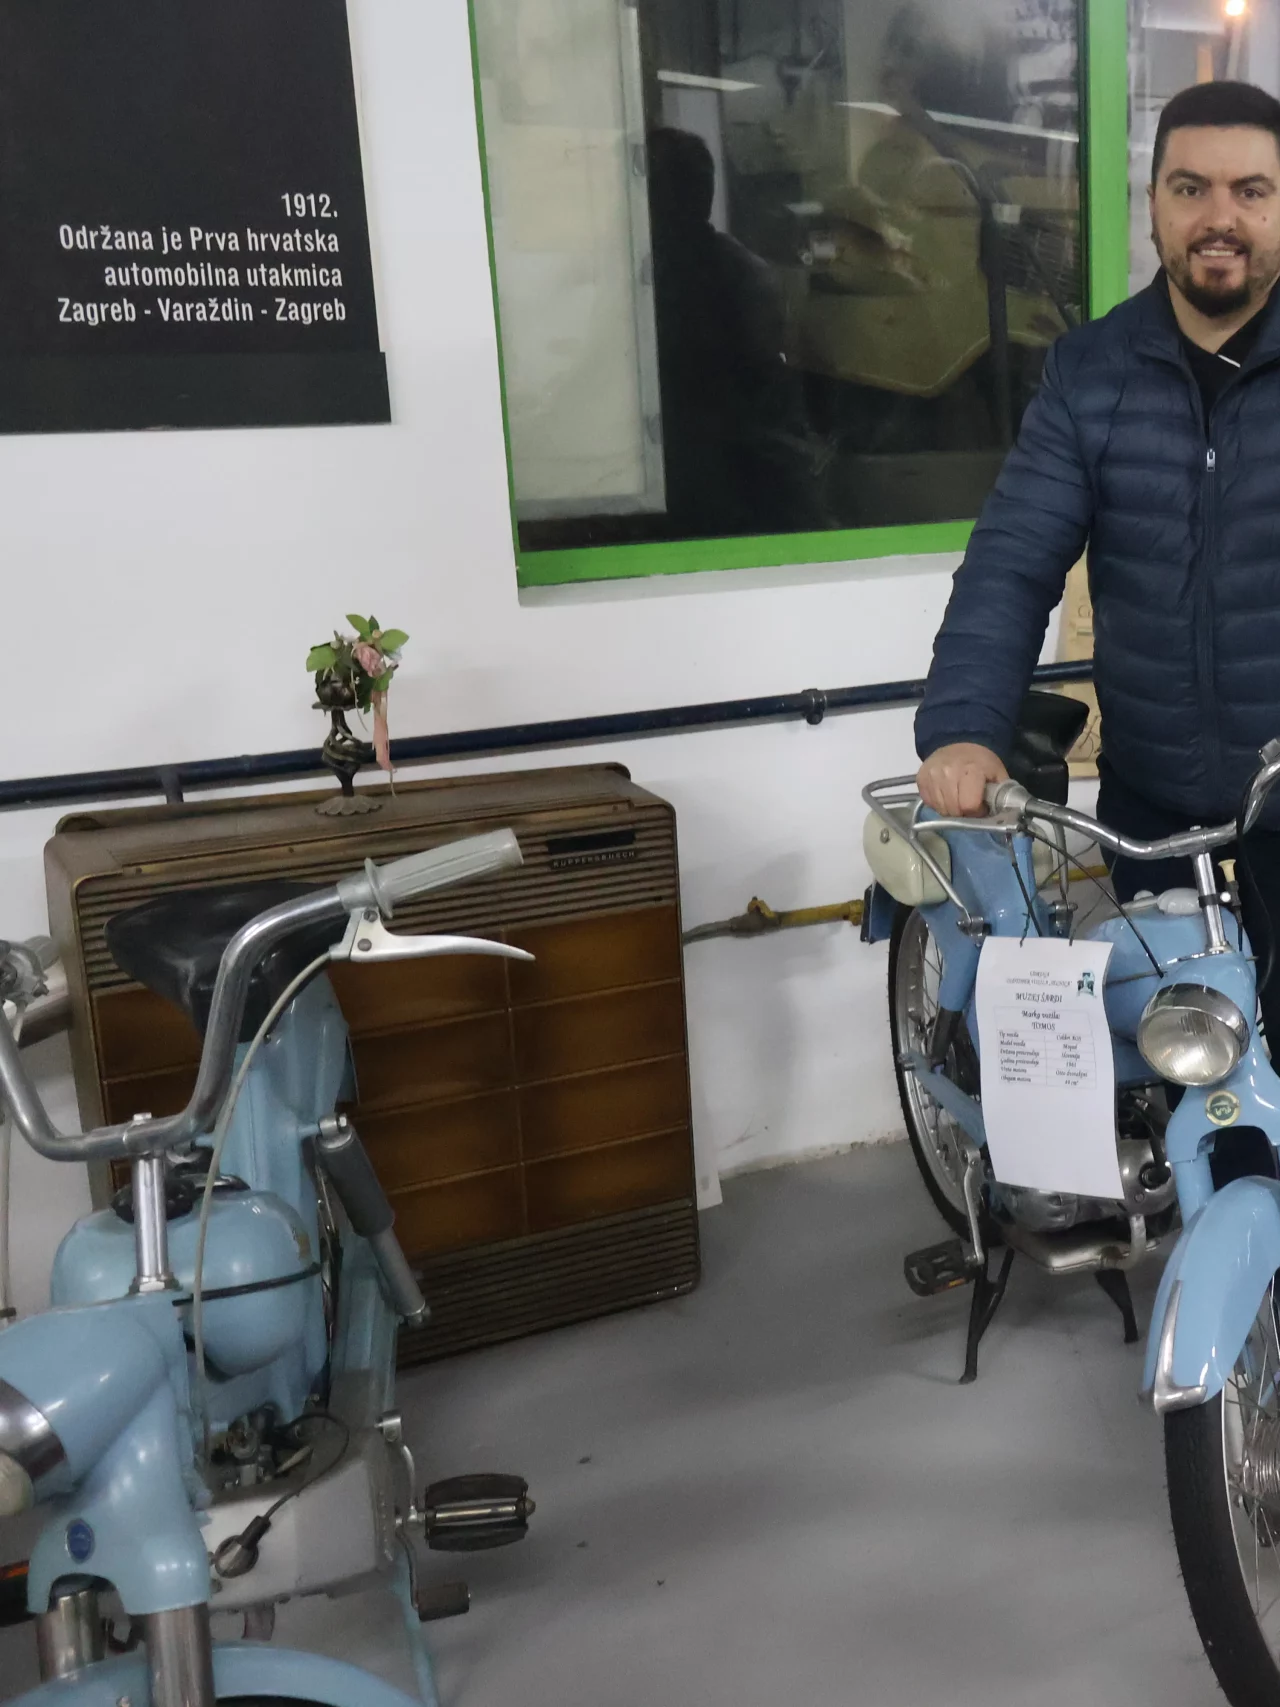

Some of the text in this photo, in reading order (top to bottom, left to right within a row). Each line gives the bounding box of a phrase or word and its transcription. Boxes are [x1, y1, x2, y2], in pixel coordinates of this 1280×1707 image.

[281, 193, 338, 218] 1912.
[59, 224, 339, 254] Održana je Prva hrvatska
[104, 262, 343, 287] automobilna utakmica
[58, 297, 136, 326] Zagreb
[157, 298, 253, 323] Varaždin
[275, 297, 346, 325] Zagreb
